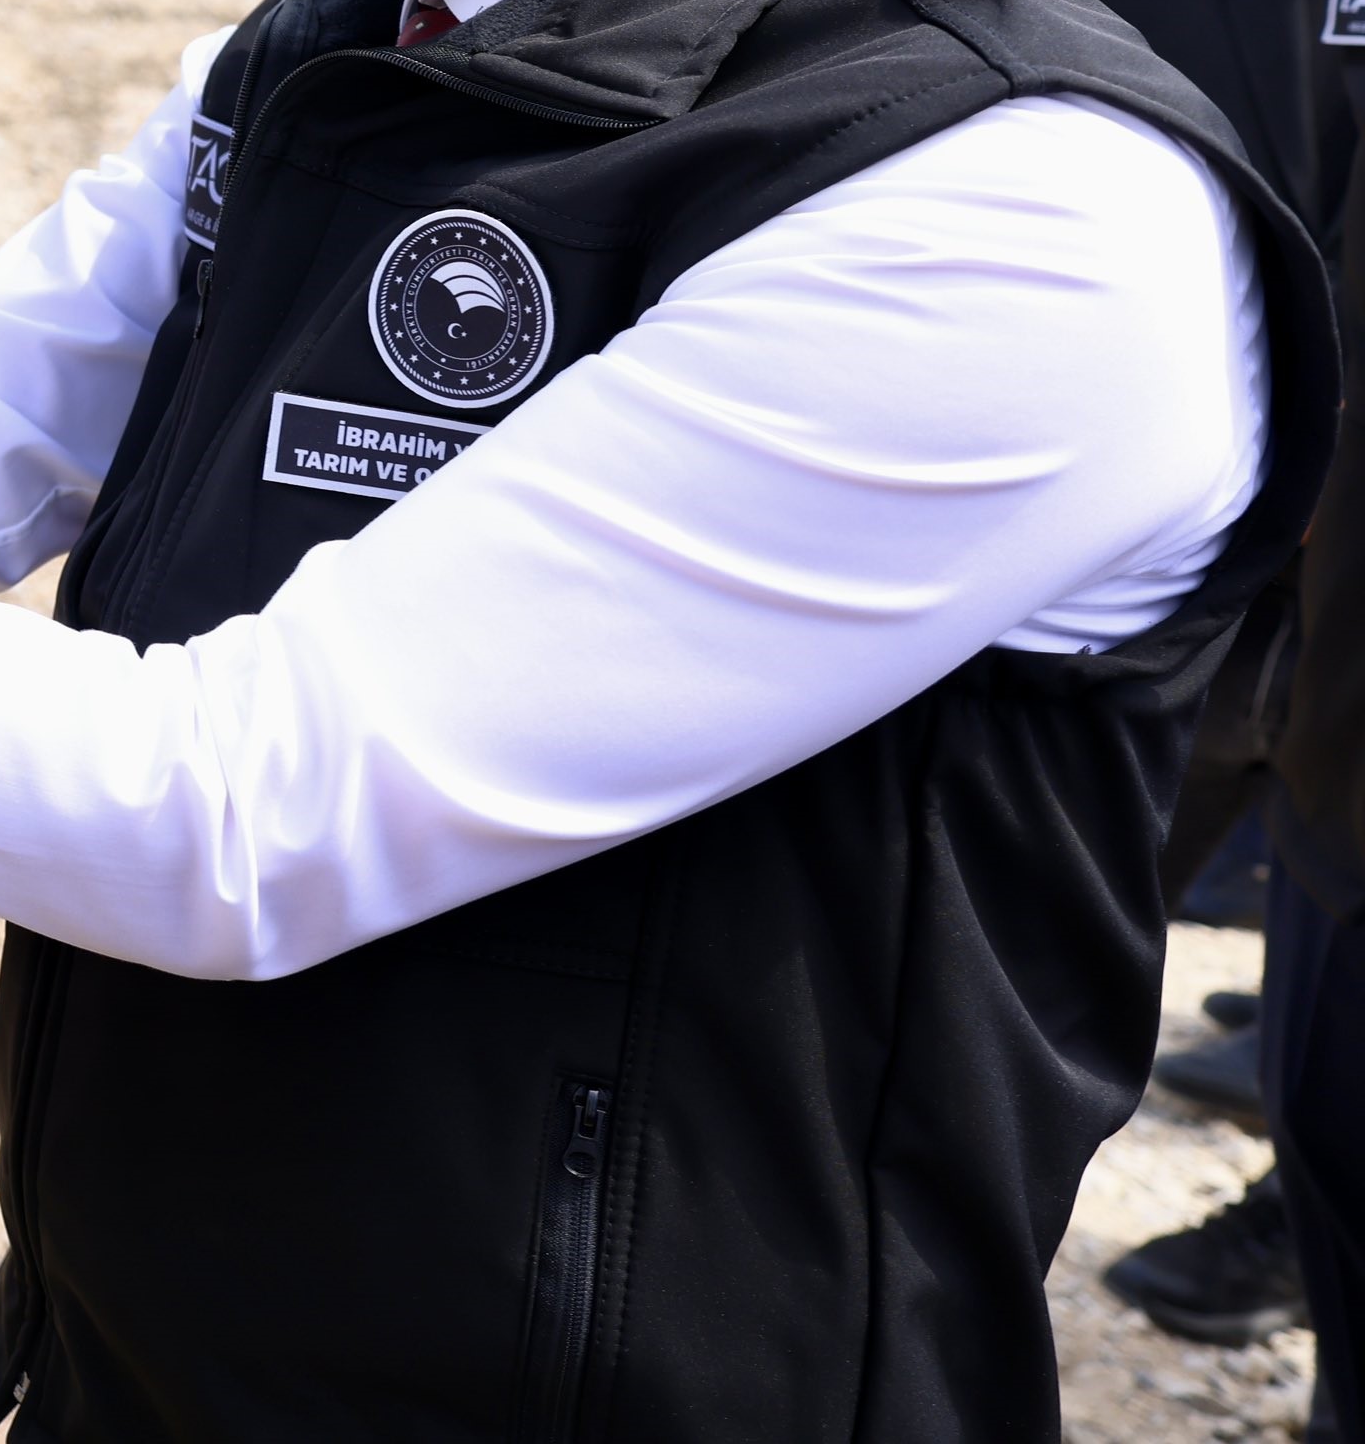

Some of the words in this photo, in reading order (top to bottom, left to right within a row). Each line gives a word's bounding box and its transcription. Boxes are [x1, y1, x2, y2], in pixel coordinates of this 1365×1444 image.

[408, 248, 462, 296] CUMHURİYETİ
[467, 249, 496, 269] TARIM
[497, 270, 508, 284] VE
[506, 289, 518, 327] ORMAN
[466, 332, 514, 369] BAKANLIĞI
[336, 419, 446, 461] İBRAHİM
[294, 448, 369, 477] TARIM
[376, 460, 408, 483] VE
[414, 467, 438, 486] O
